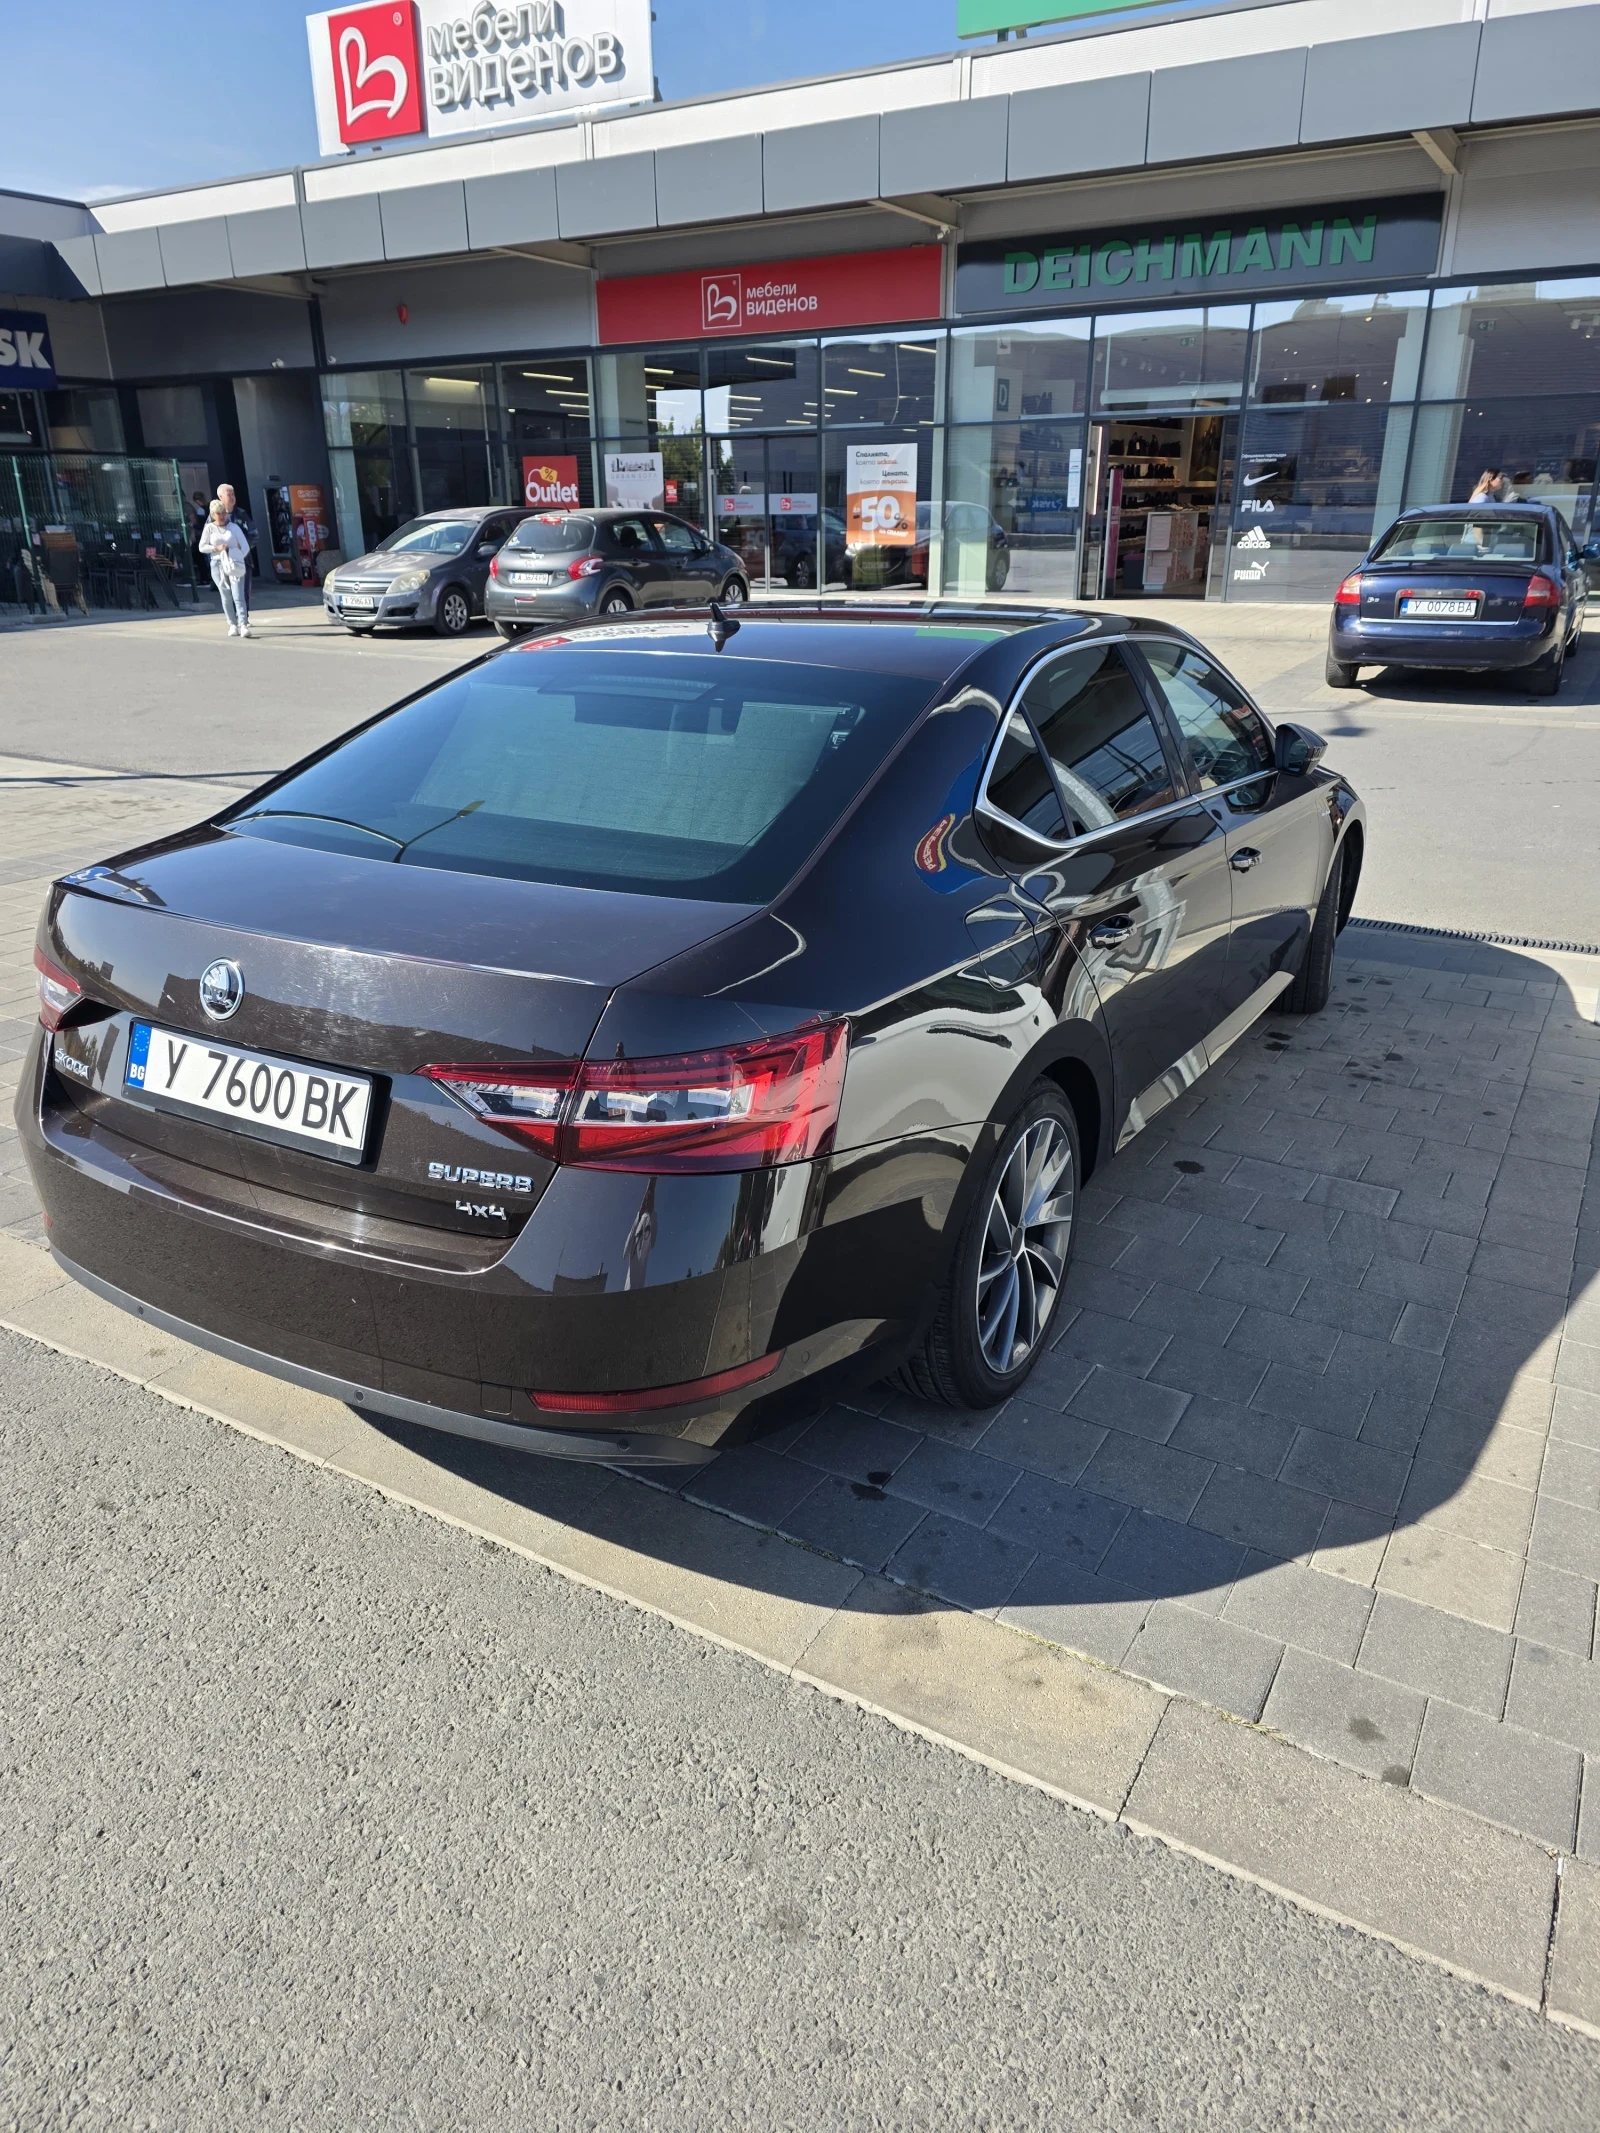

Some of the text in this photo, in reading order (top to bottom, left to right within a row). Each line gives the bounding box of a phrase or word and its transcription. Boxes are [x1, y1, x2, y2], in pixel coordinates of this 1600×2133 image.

[427, 1, 562, 57] мебели
[1004, 215, 1377, 294] DEICHMANN
[747, 282, 797, 299] мебели
[525, 481, 579, 503] Outlet
[1241, 499, 1275, 512] FILA
[1237, 539, 1271, 549] adidas
[1234, 569, 1261, 580] PUMA
[54, 1048, 91, 1081] ŠKODA
[130, 1063, 145, 1080] BG
[427, 1162, 534, 1193] SUPERB
